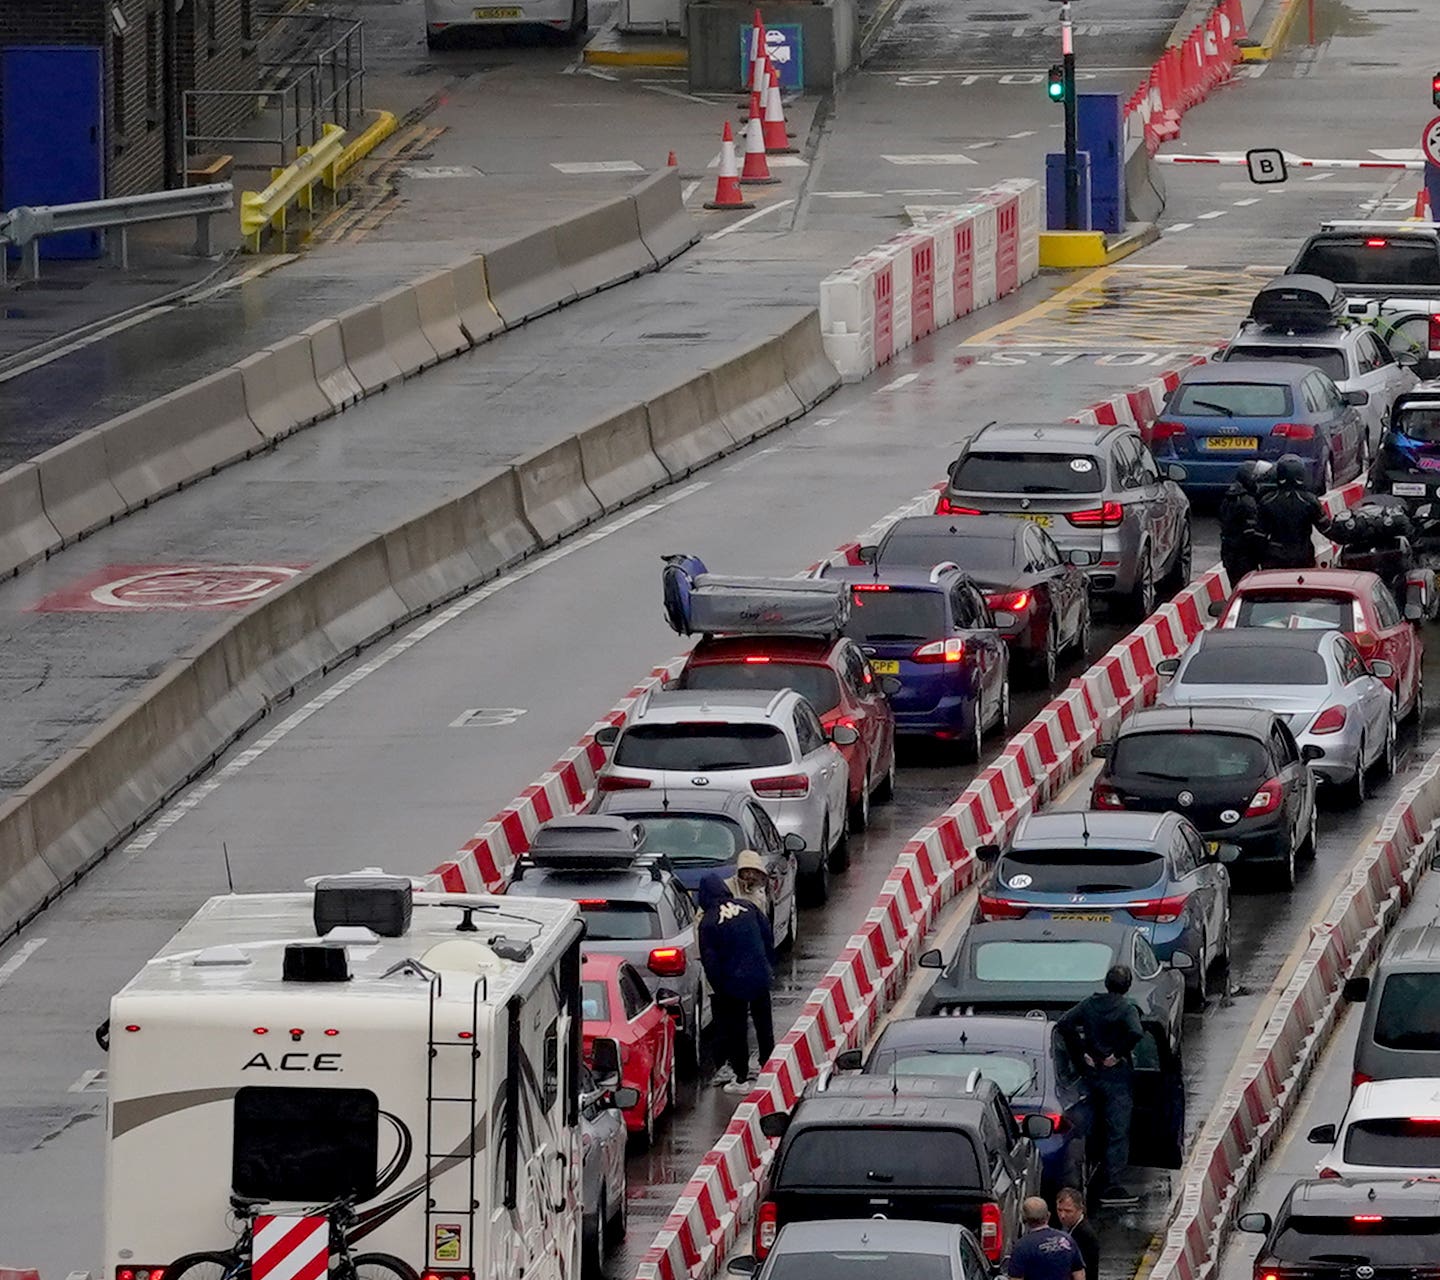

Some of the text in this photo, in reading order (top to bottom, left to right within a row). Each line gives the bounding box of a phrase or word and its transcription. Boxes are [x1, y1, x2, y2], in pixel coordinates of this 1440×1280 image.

[1260, 159, 1274, 173] B
[1073, 461, 1088, 469] UK
[447, 706, 529, 727] B
[1012, 877, 1027, 886] UK
[241, 1052, 343, 1071] A.C.E.
